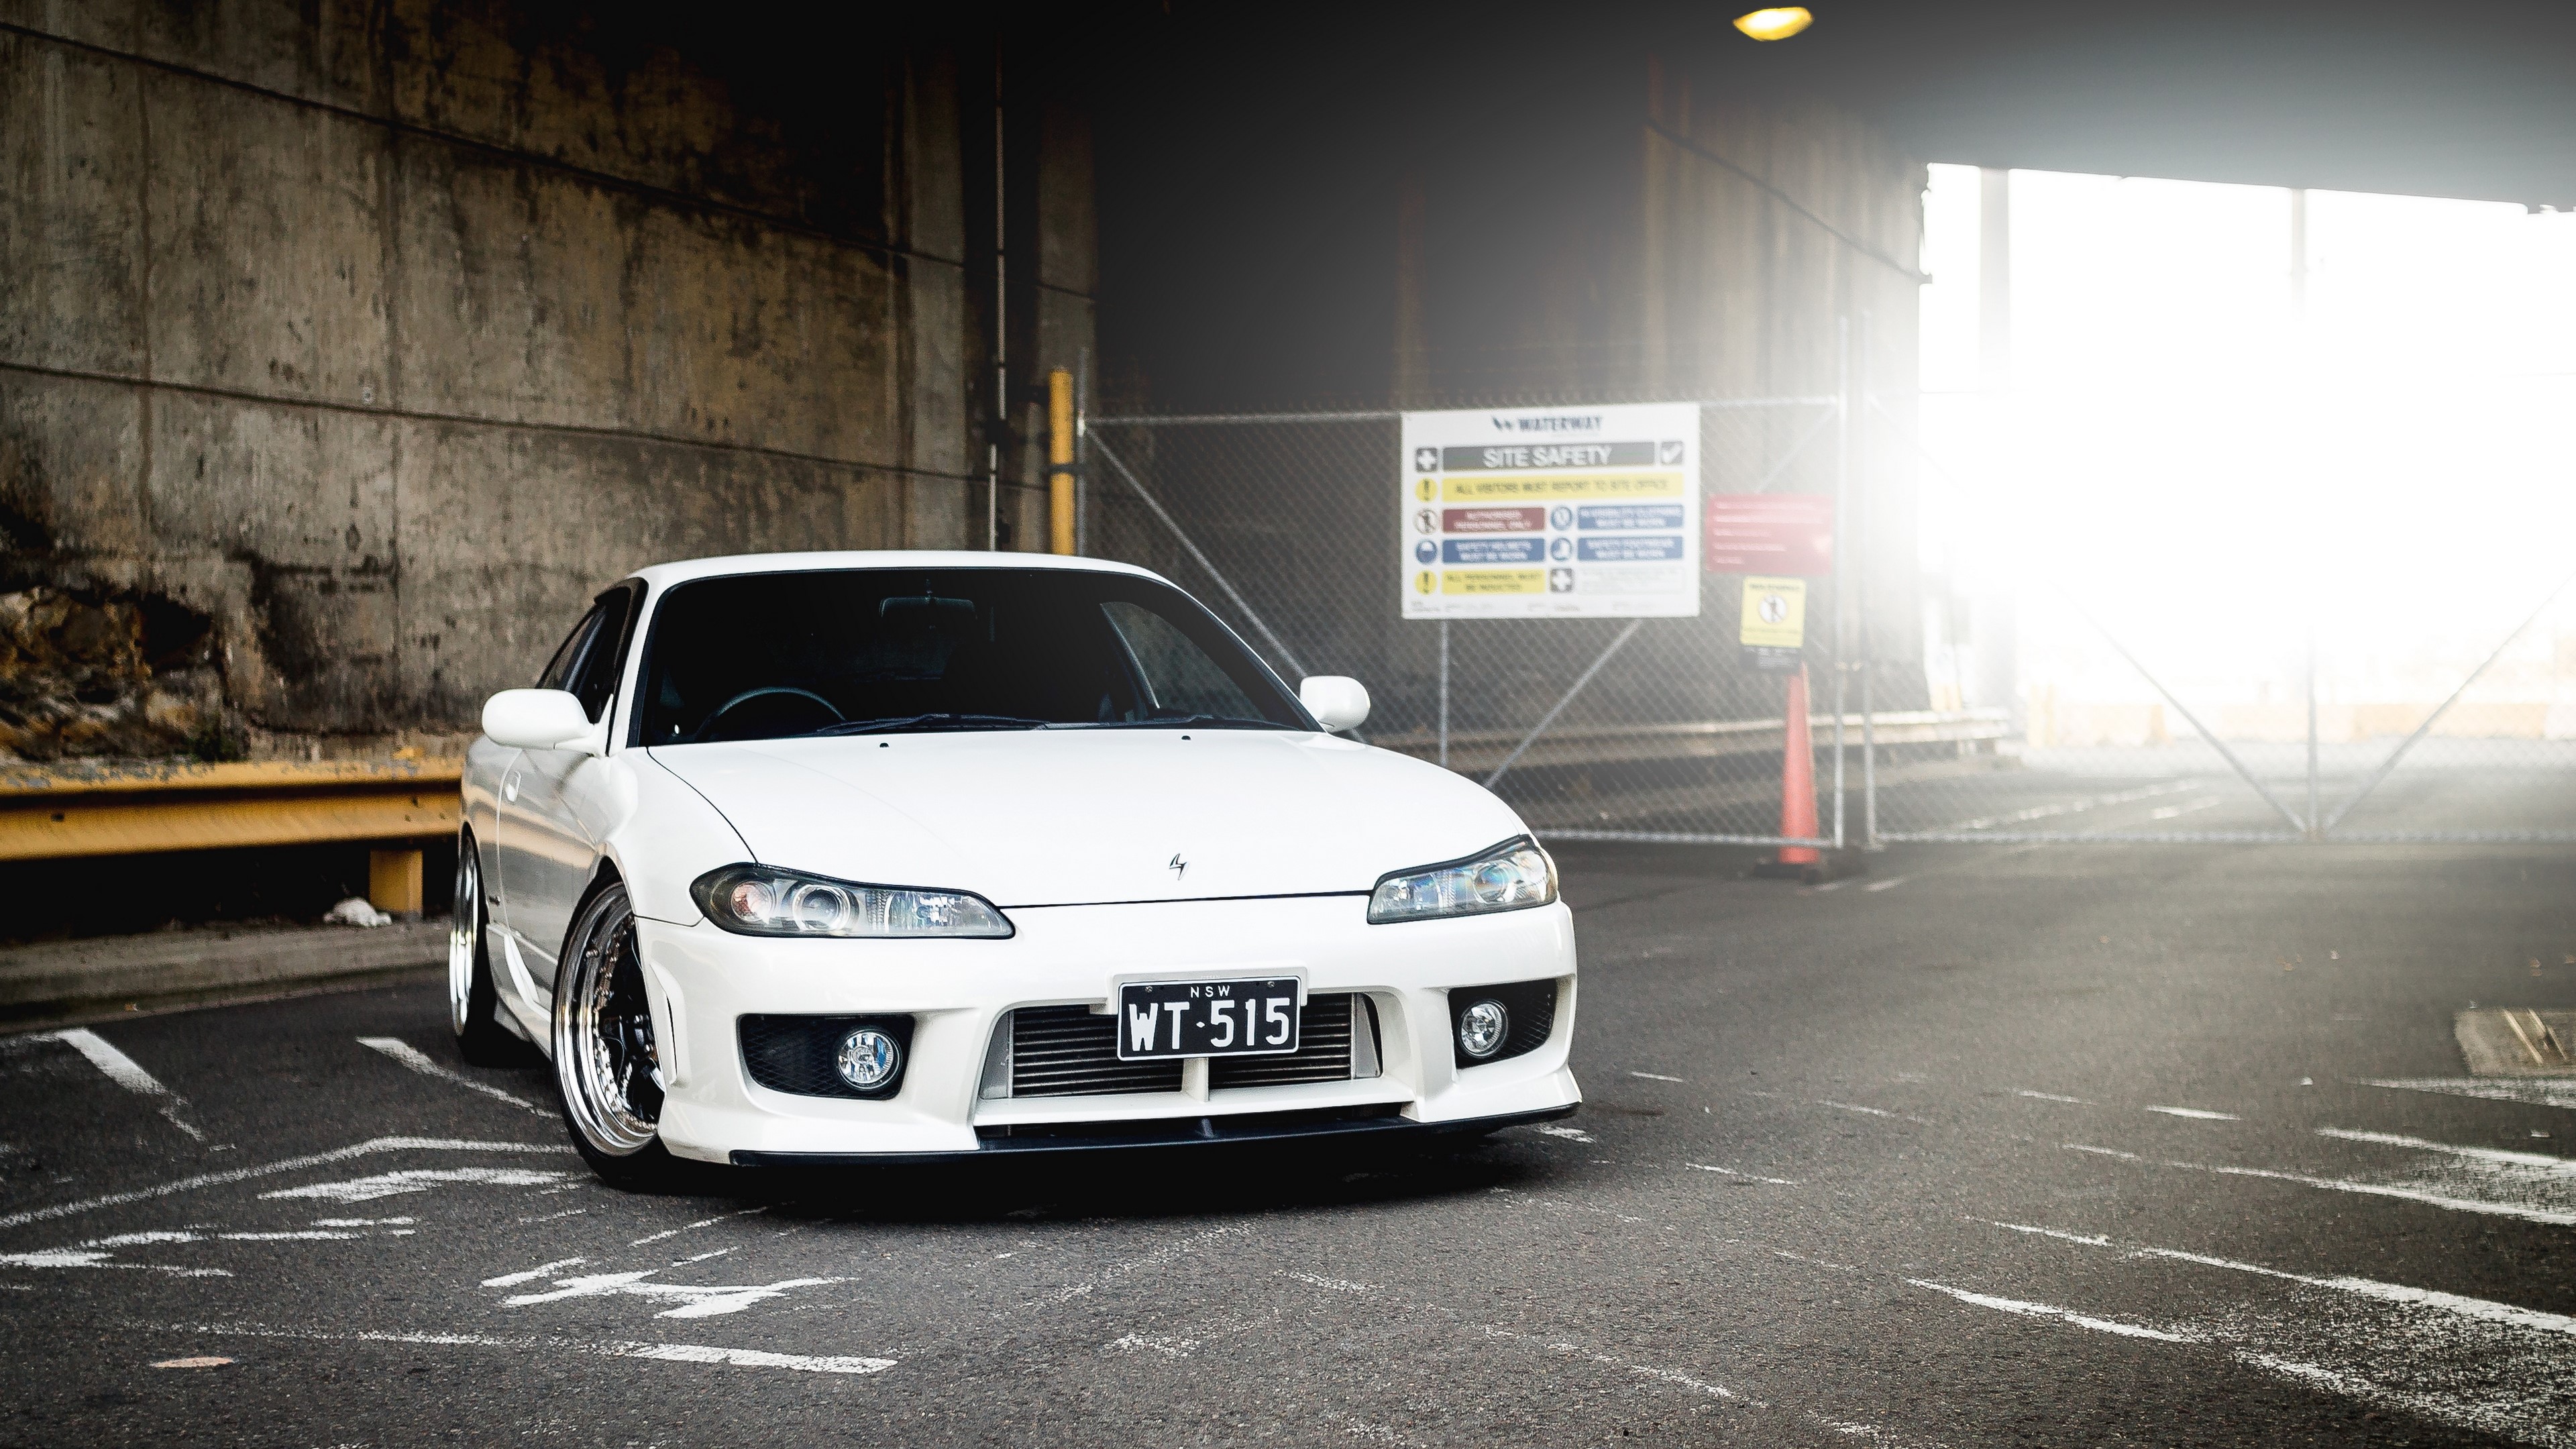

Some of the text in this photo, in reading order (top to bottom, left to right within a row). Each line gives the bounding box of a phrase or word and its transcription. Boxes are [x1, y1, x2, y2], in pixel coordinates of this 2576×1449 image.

[1518, 417, 1602, 431] WATERWAY
[1483, 445, 1612, 468] SITE SAFETY
[1455, 482, 1474, 495] ALL
[1190, 985, 1230, 998] NSW
